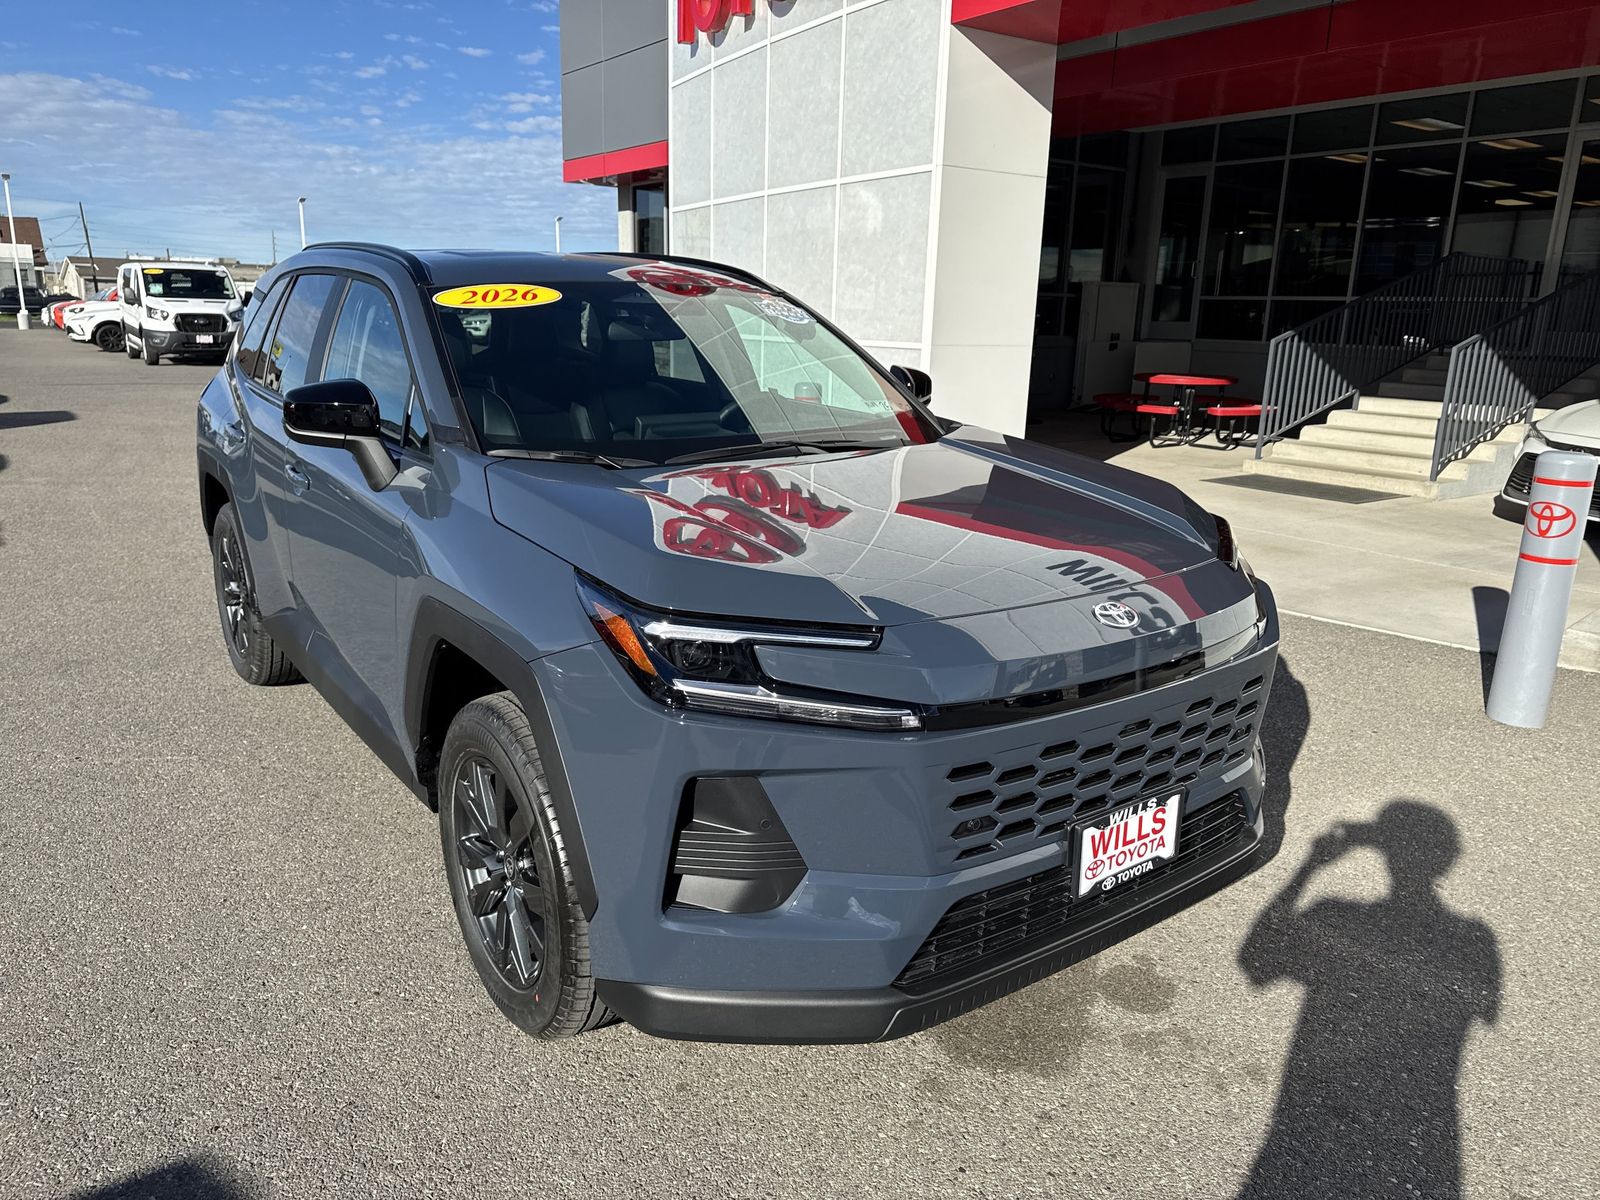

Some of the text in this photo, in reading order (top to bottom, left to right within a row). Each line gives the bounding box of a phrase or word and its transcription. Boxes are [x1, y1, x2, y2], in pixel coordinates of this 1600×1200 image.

[460, 287, 540, 305] 2026
[1109, 797, 1158, 826] WILLS
[1090, 807, 1166, 860] WILLS
[1106, 835, 1166, 871] TOYOTA
[1117, 860, 1154, 884] TOYOTA
